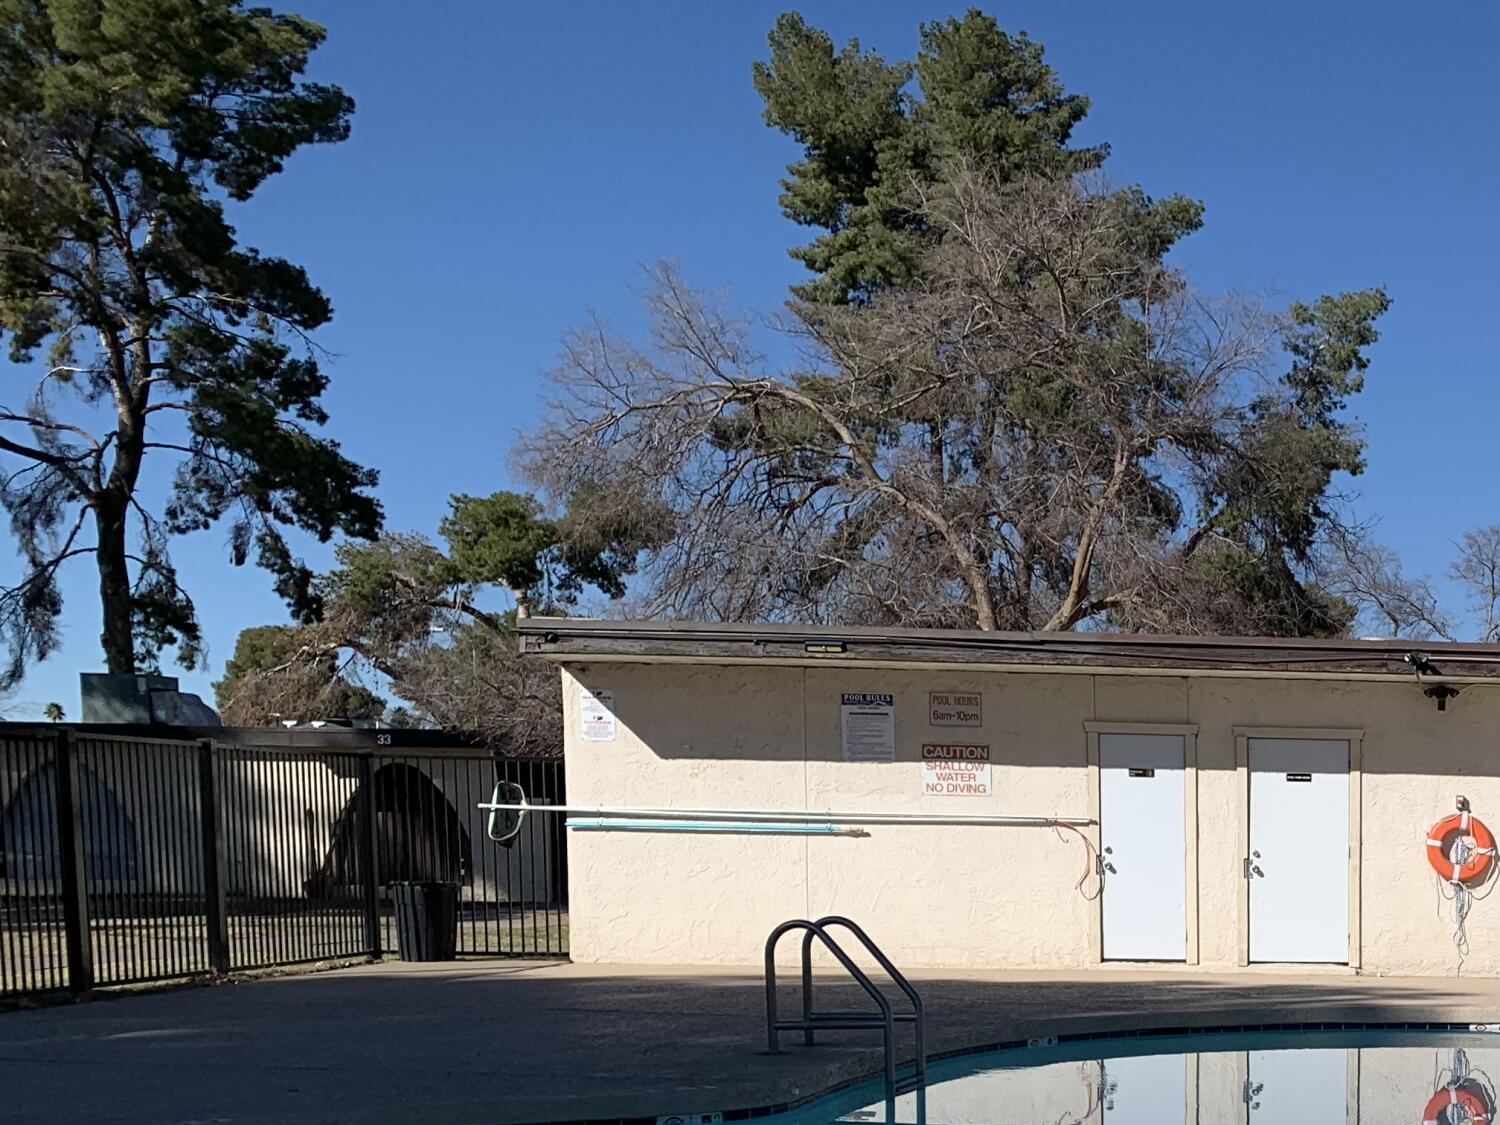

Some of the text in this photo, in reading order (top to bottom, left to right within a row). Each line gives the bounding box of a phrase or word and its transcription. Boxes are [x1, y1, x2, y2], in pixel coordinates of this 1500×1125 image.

[932, 695, 979, 706] POOL HOURS
[932, 710, 979, 722] 6am-10pm
[377, 734, 391, 745] 33
[923, 746, 988, 758] CAUTION
[926, 760, 985, 772] SHALLOW
[936, 772, 977, 783] WATER
[925, 782, 987, 794] NO DIVING
